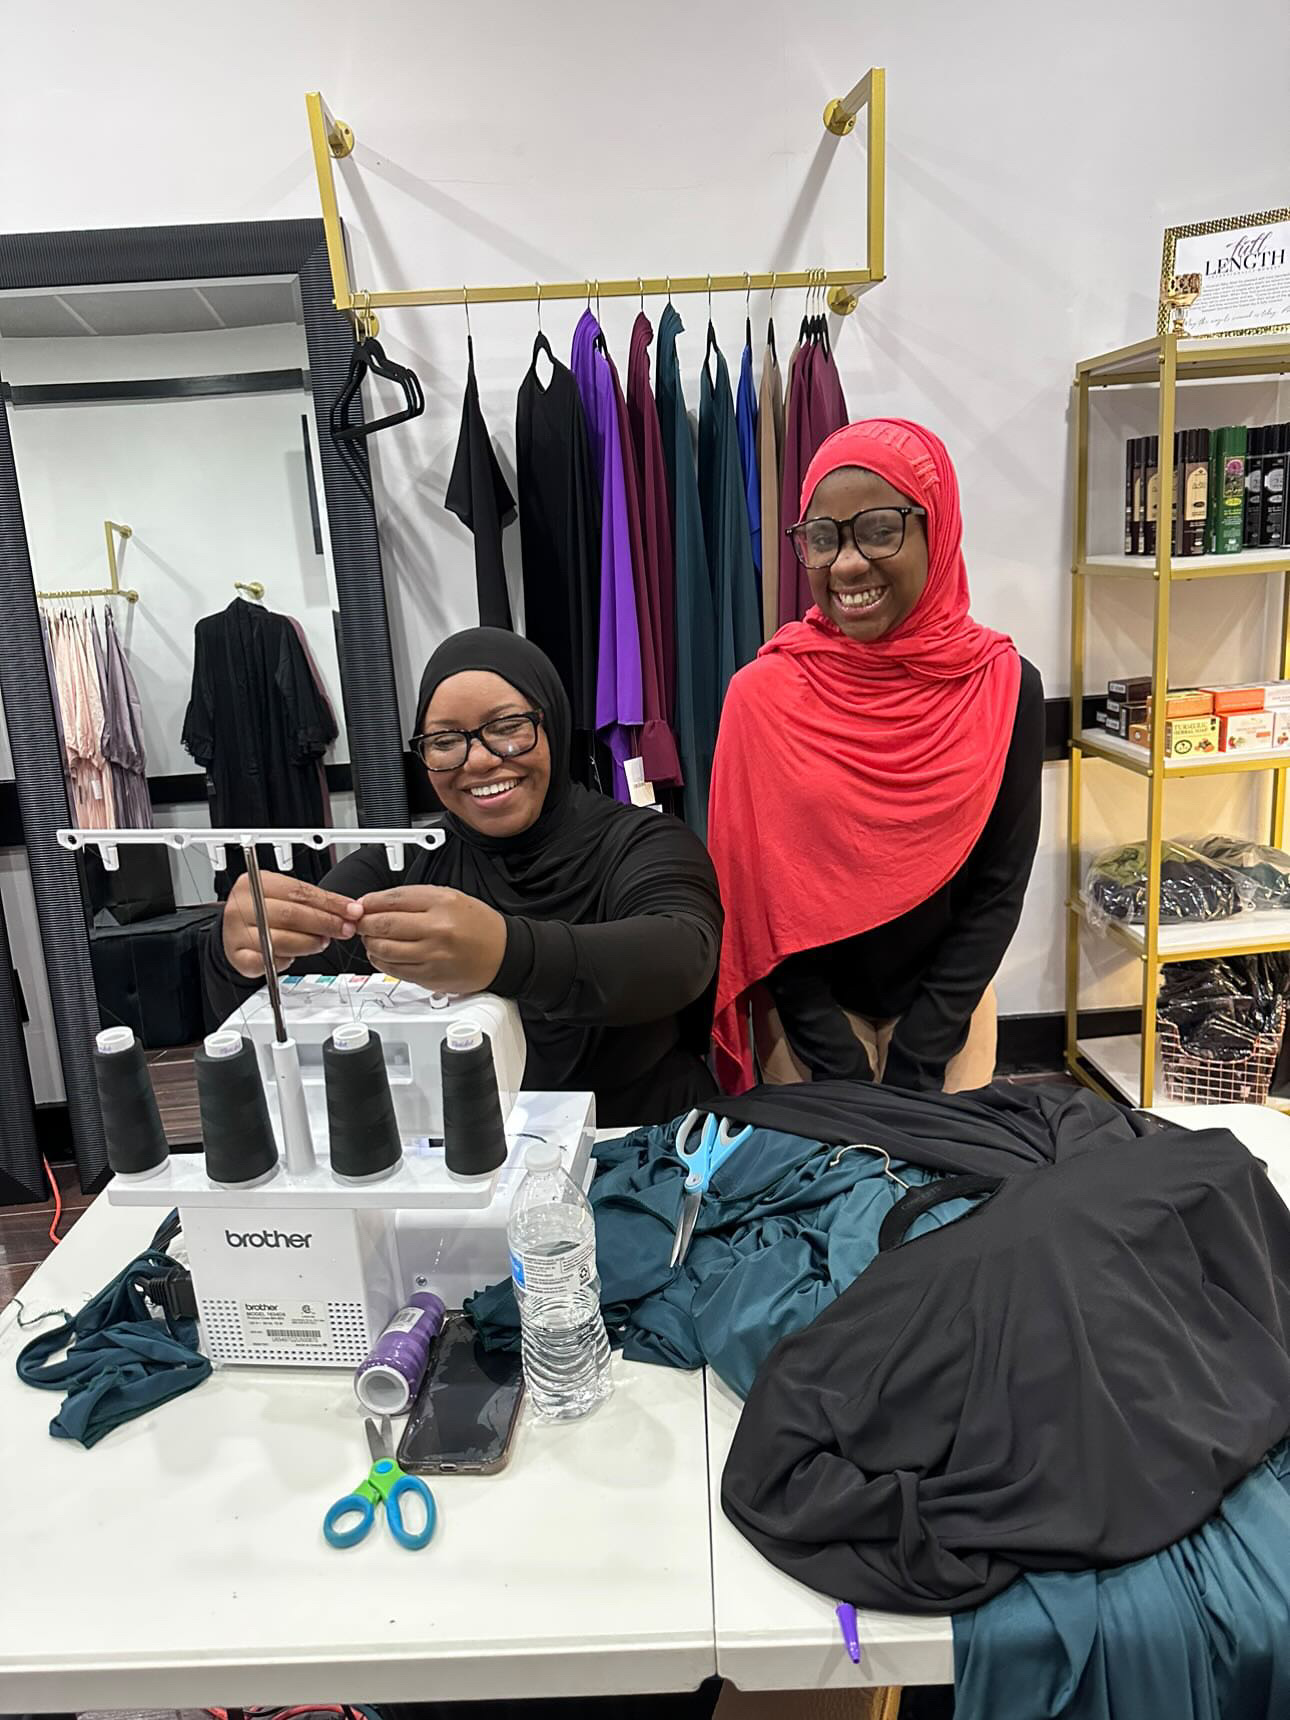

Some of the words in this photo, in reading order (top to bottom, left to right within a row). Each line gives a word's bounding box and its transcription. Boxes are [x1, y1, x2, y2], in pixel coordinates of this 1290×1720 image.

[1205, 249, 1285, 276] LENGTH
[225, 1229, 313, 1248] brother
[245, 1303, 279, 1312] brother
